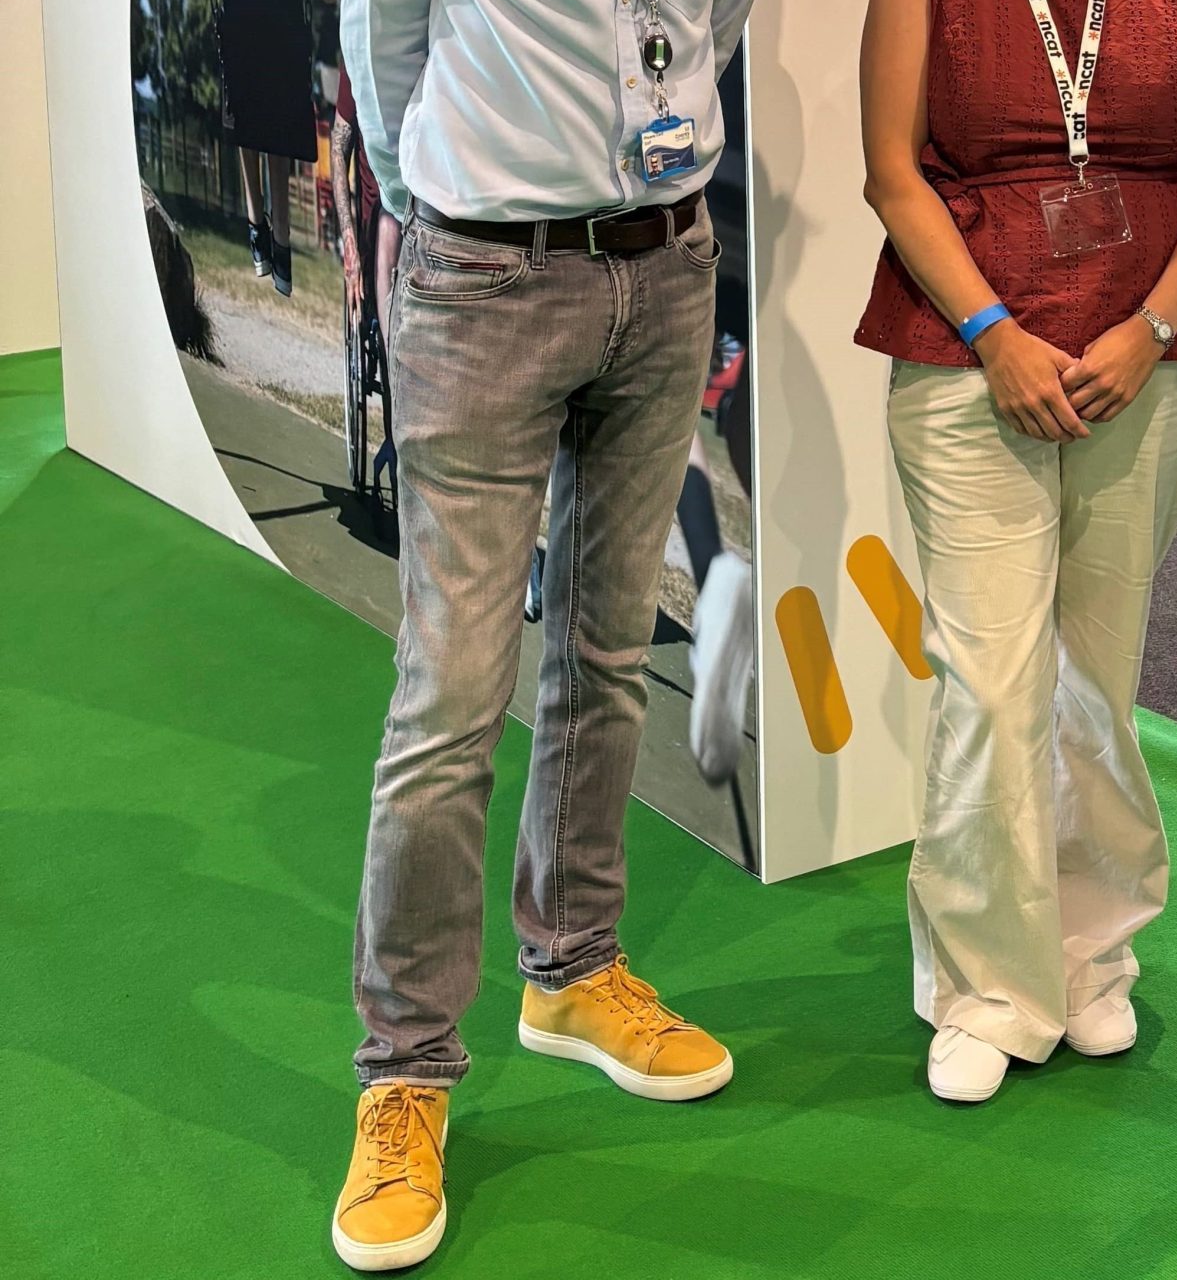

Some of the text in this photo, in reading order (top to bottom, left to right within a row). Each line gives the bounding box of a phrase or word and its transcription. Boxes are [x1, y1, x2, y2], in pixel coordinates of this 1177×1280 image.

[1040, 20, 1062, 58] ncat
[1079, 51, 1096, 90] ncat
[1072, 112, 1085, 140] cat
